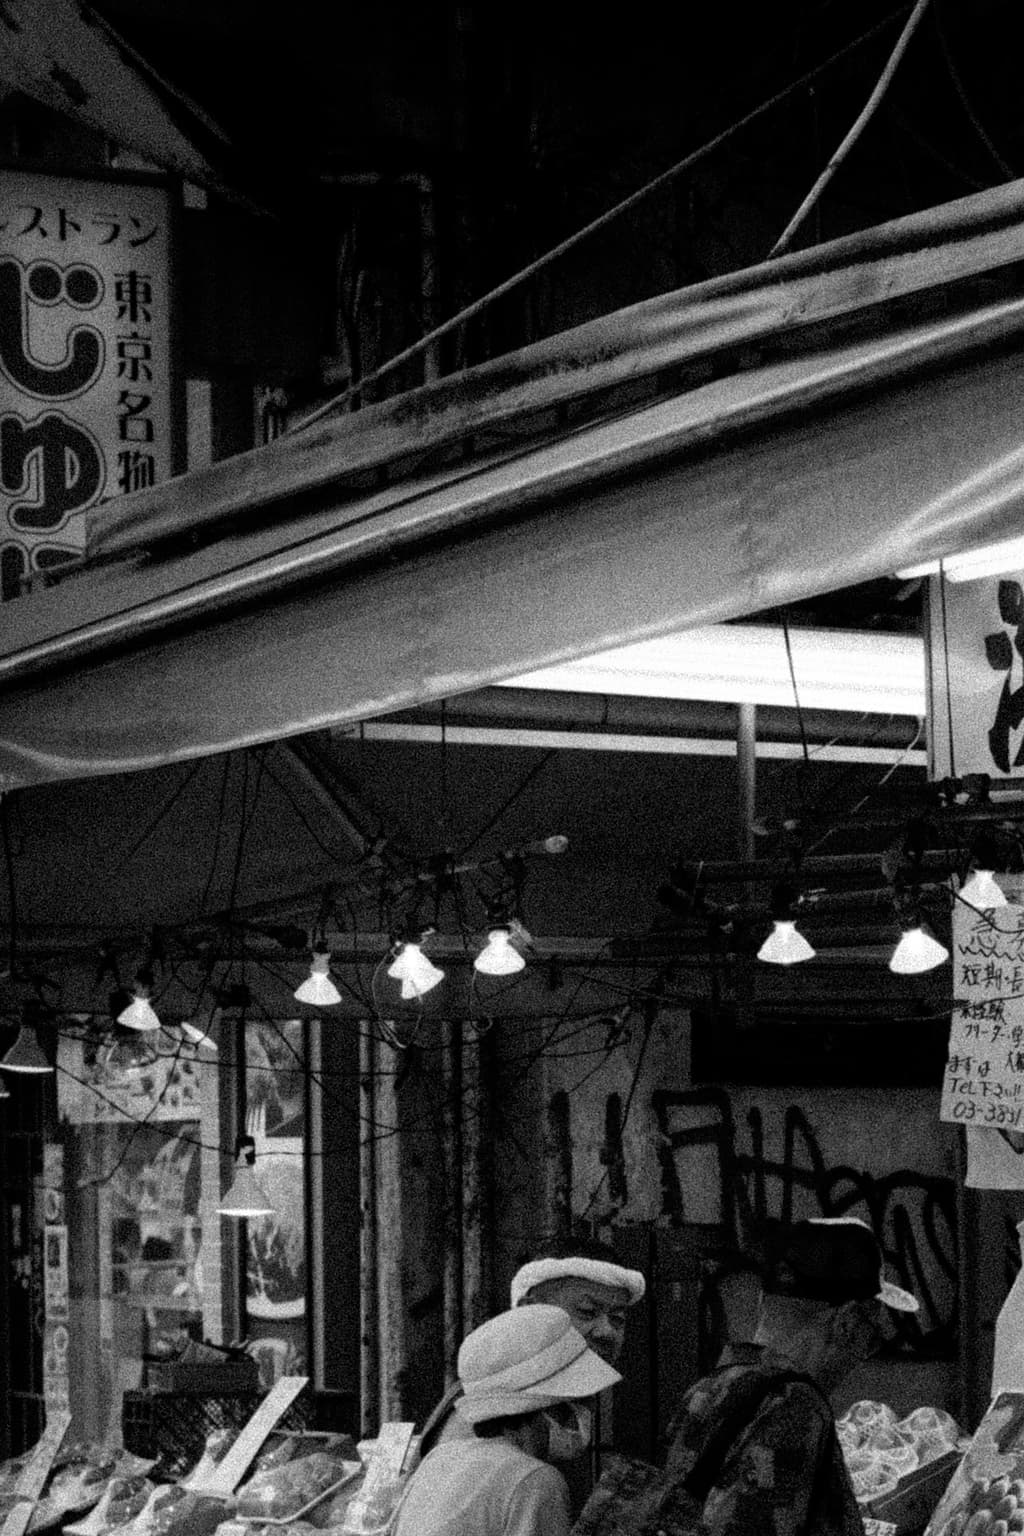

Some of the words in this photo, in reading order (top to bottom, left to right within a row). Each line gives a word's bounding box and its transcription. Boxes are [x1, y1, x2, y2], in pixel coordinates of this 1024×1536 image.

[0, 204, 158, 248] ストラン
[113, 270, 155, 494] 東京名物
